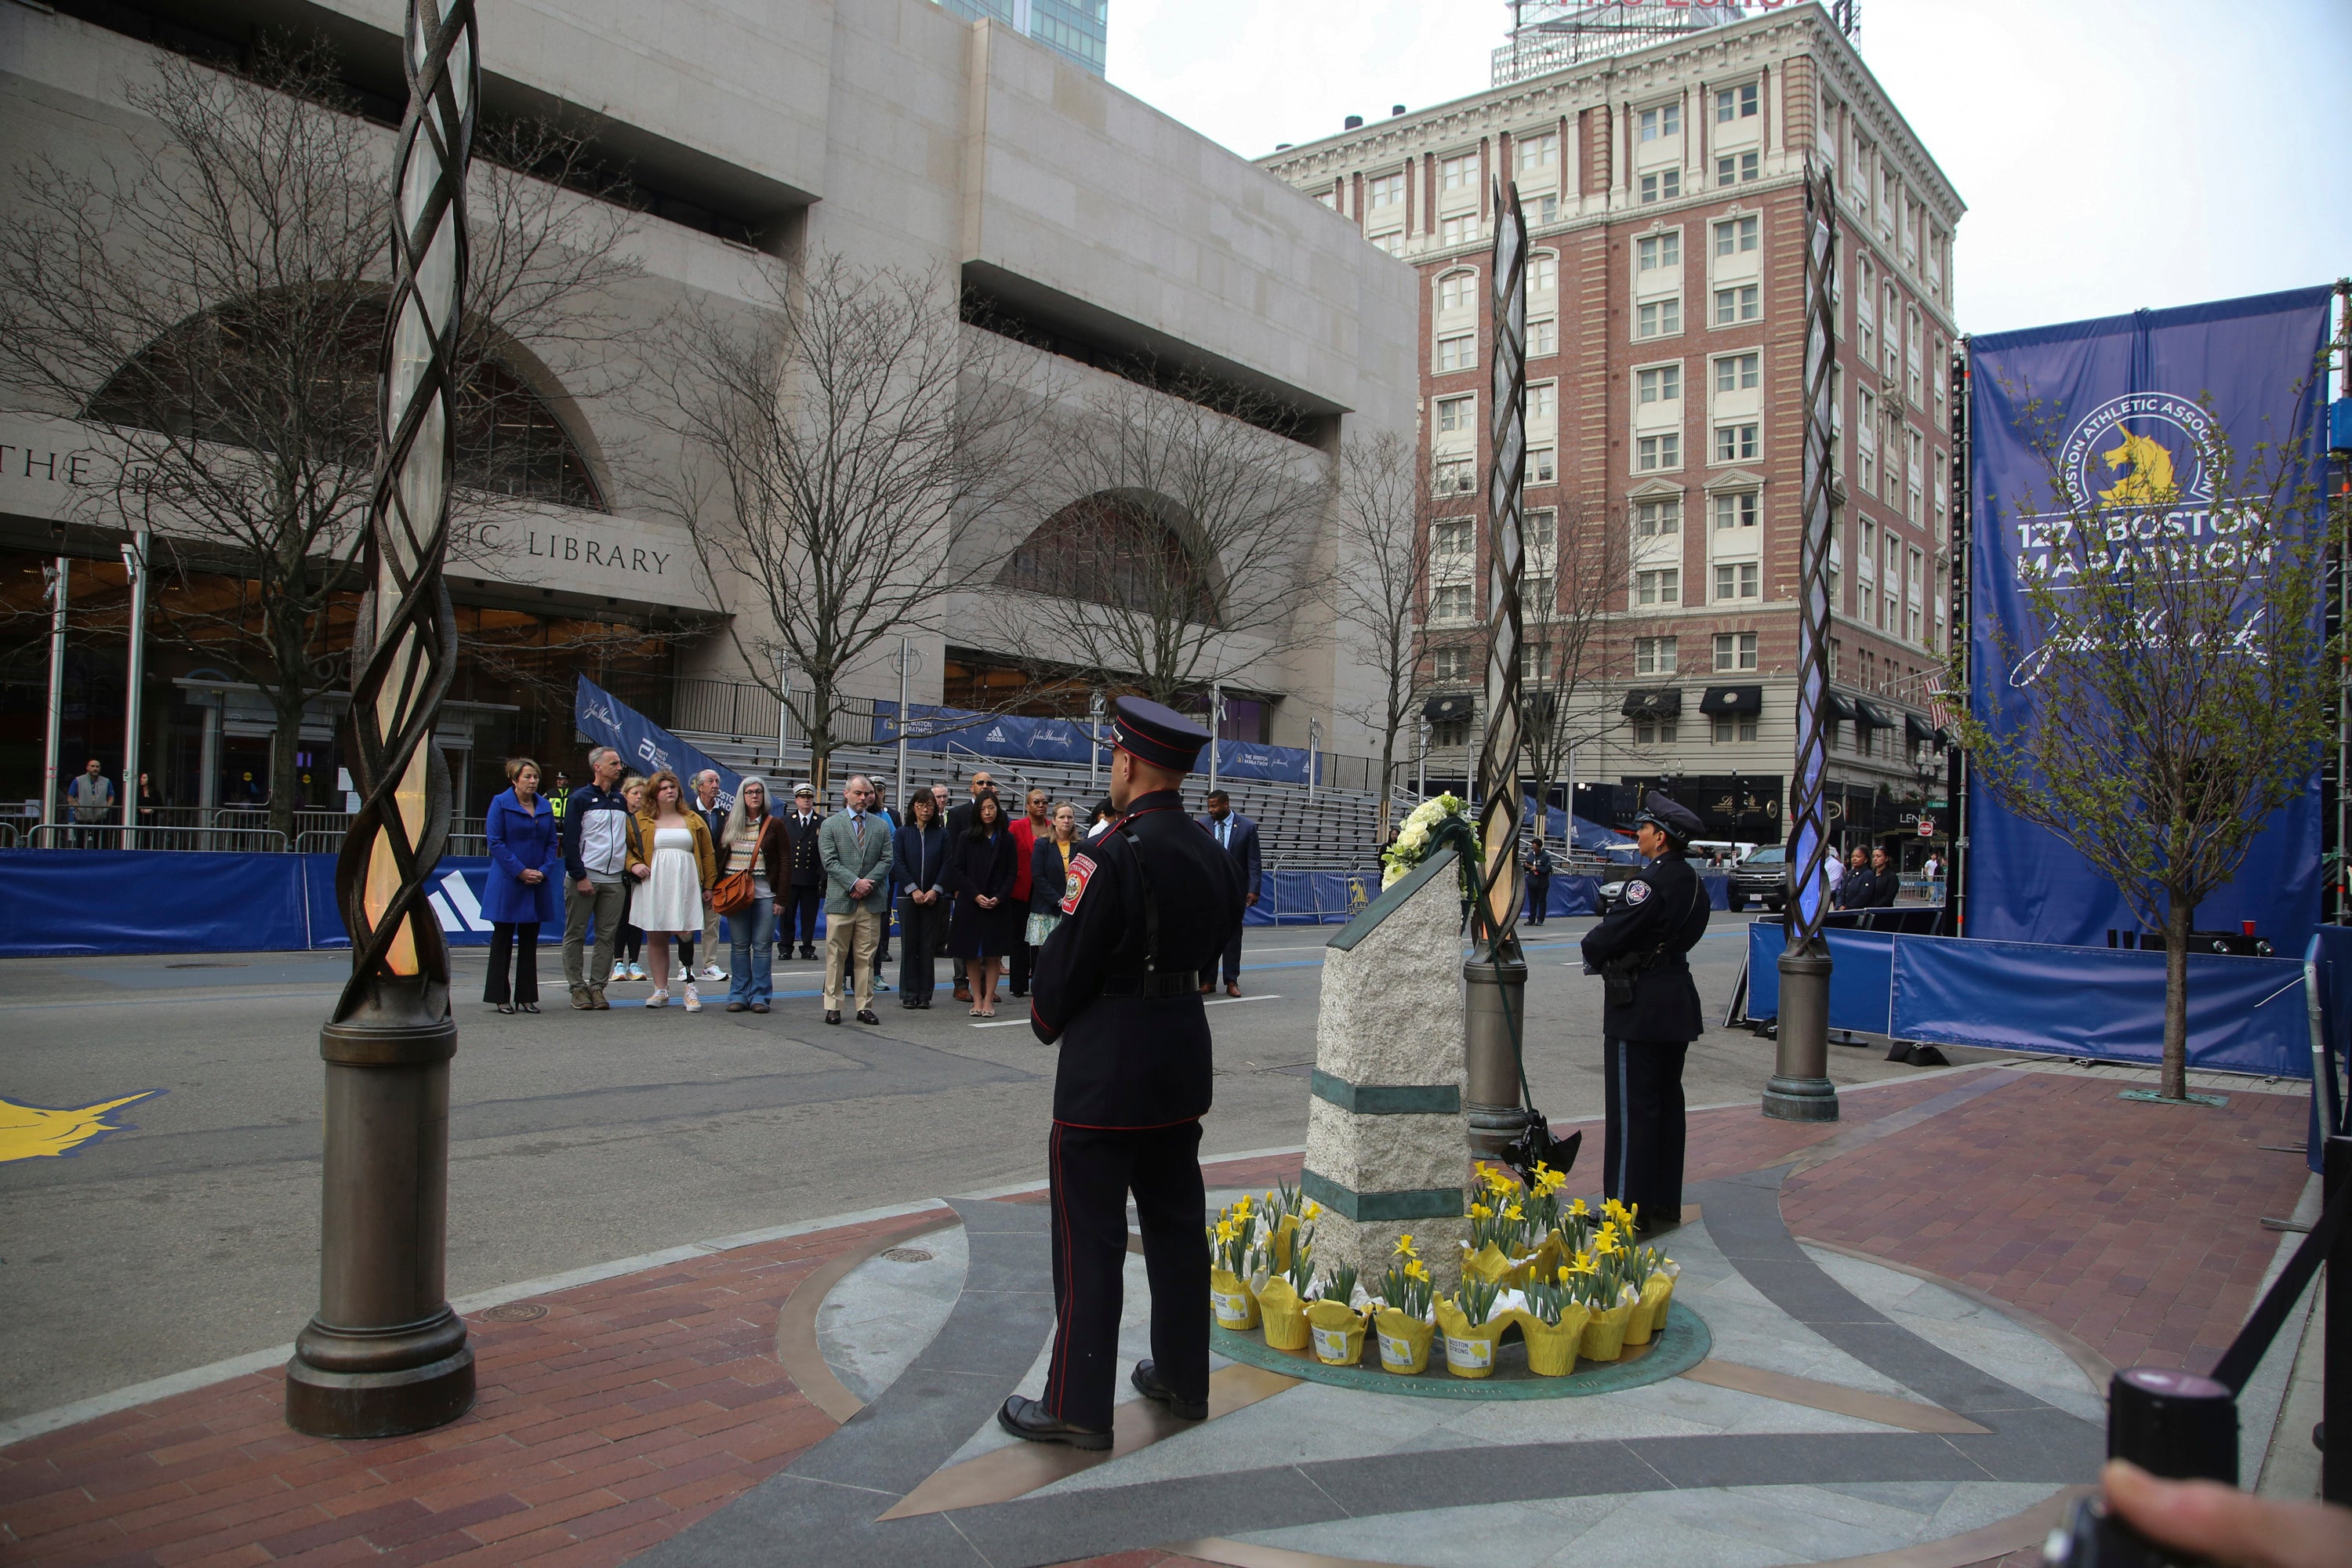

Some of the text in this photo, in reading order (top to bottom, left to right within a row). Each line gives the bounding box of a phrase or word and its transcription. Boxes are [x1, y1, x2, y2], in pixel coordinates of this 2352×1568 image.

[2065, 439, 2085, 504] BOSTON
[2082, 398, 2158, 439] ATHLETIC
[0, 445, 92, 487] THE
[528, 531, 672, 575] LIBRARY
[2106, 506, 2271, 542] BOSTON
[1028, 728, 1072, 748] John Hancock
[1900, 813, 1936, 824] LENX
[1449, 1338, 1469, 1348] BOSTON
[1450, 1345, 1469, 1356] STRONG
